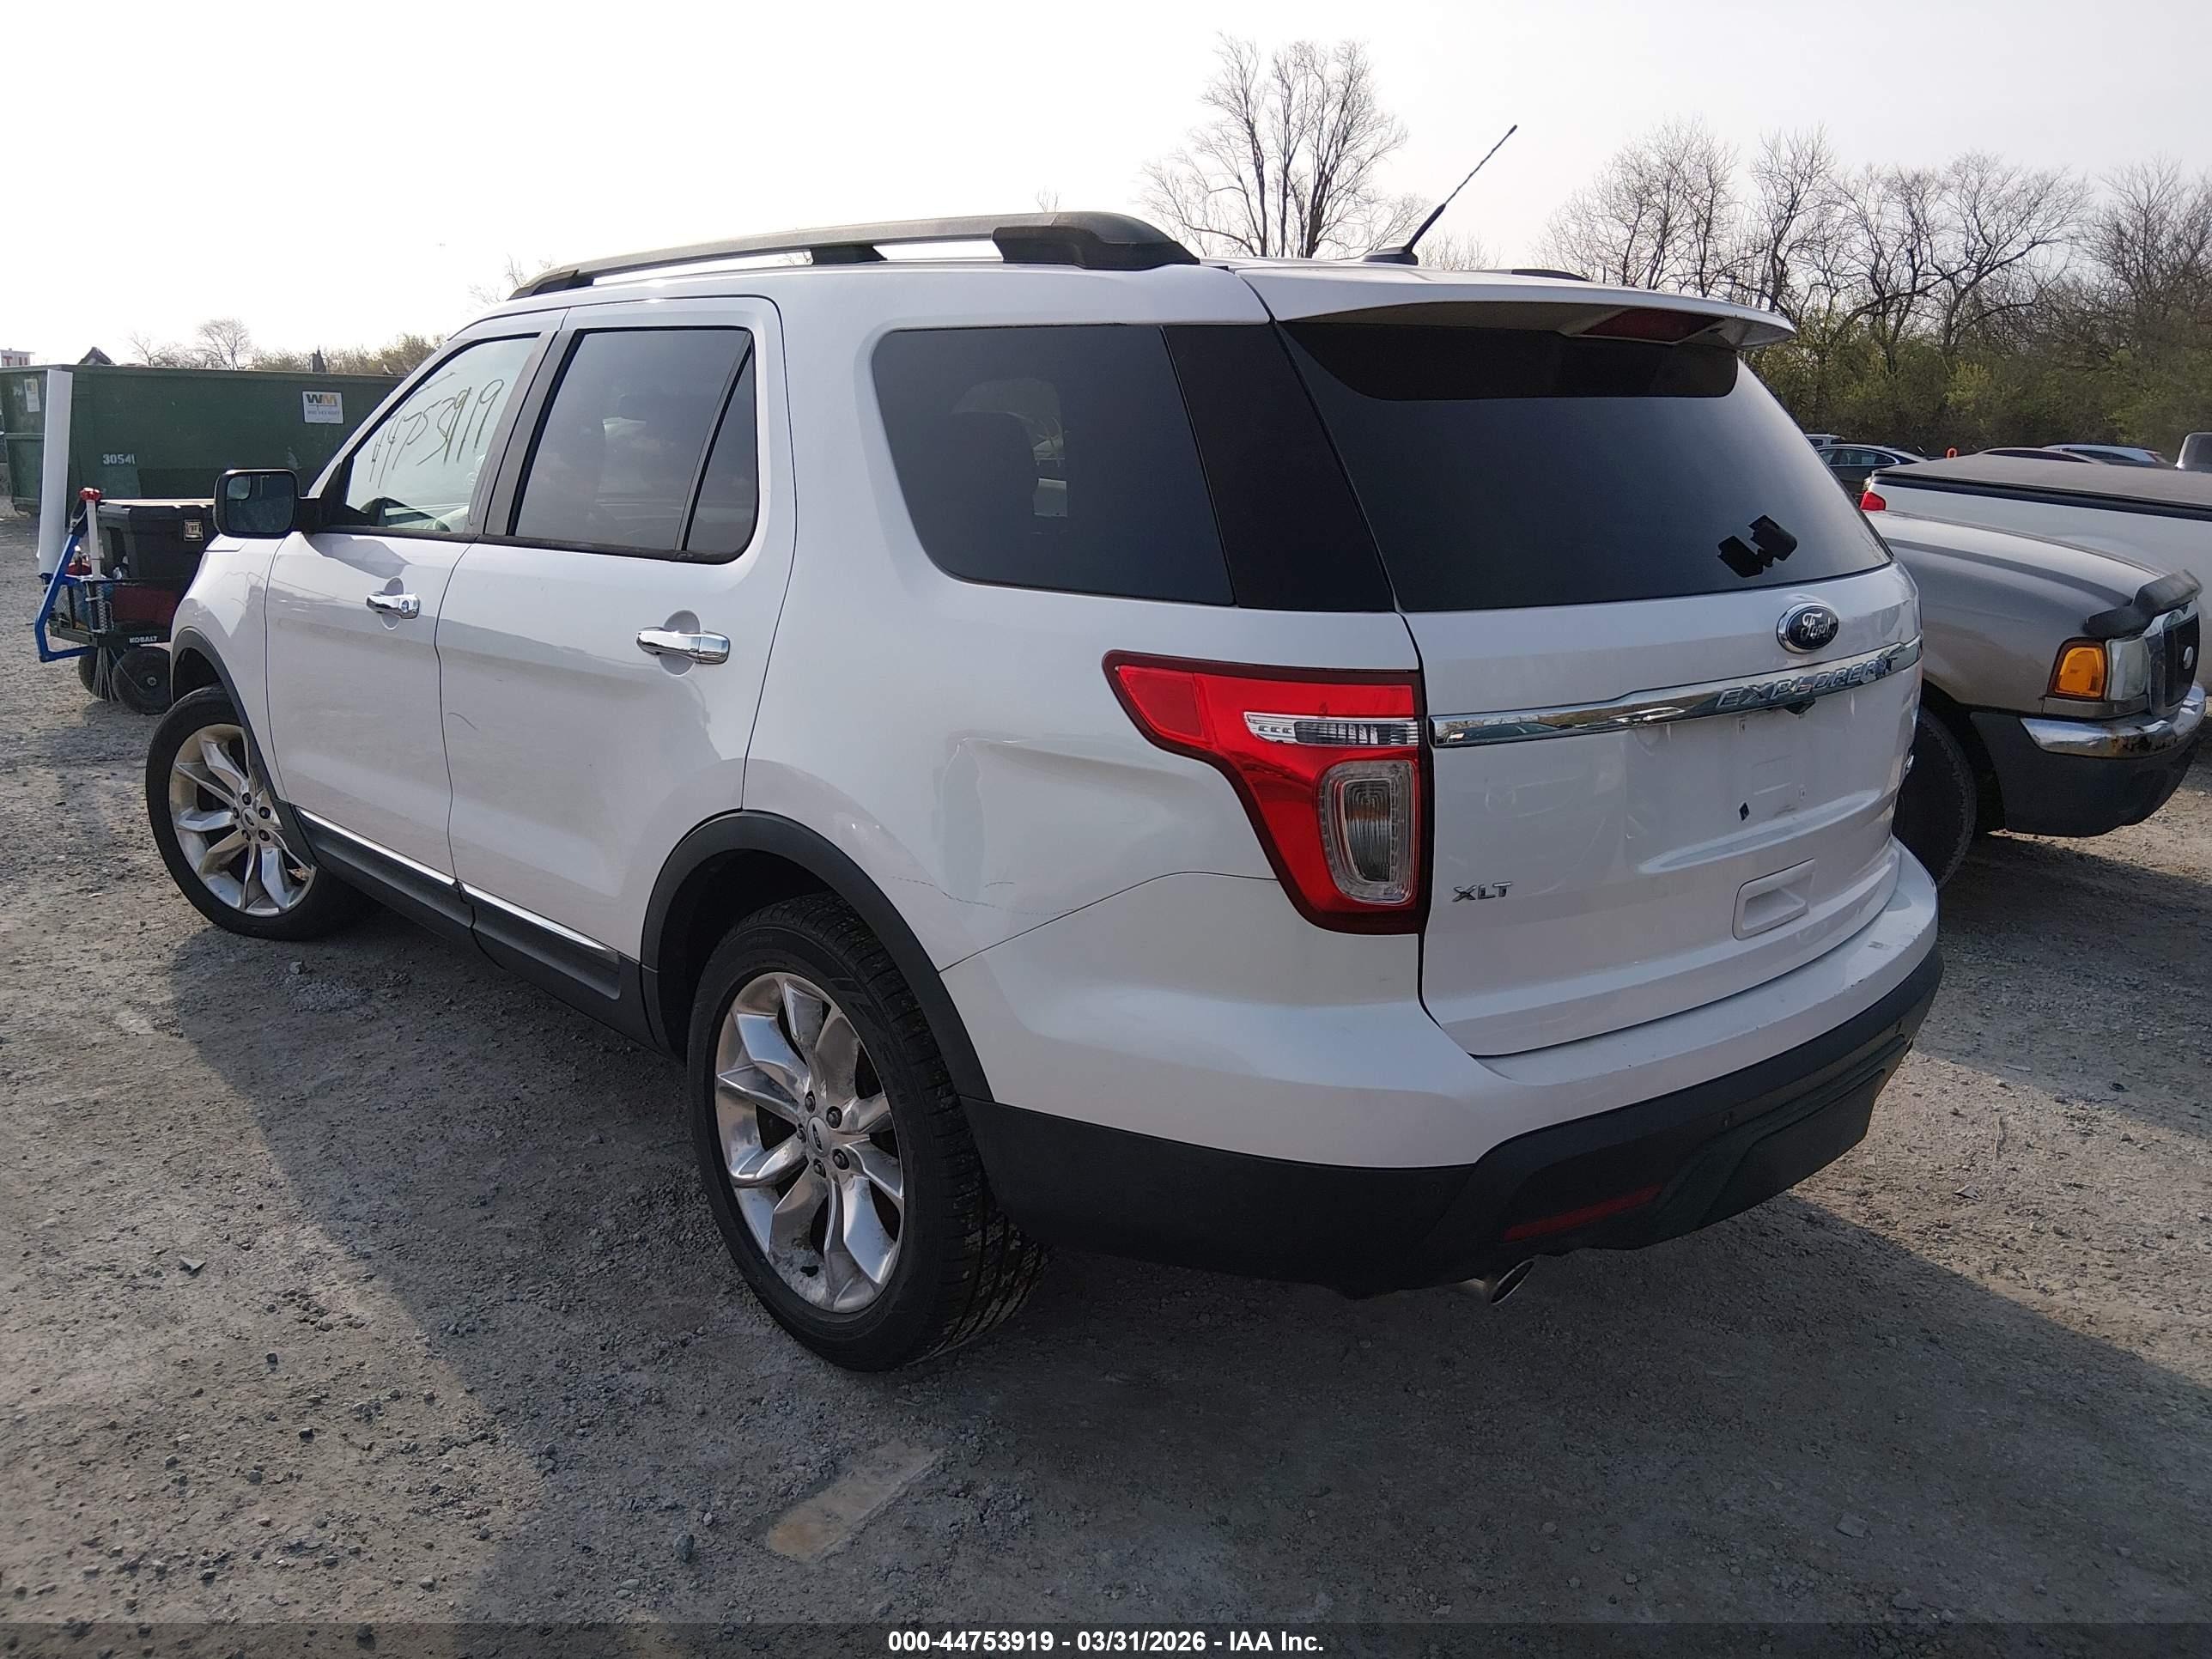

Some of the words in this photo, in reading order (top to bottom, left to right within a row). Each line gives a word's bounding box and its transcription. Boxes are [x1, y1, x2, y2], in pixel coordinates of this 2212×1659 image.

[306, 393, 337, 405] WM
[102, 453, 136, 465] 30541
[1800, 611, 1832, 640] Ford
[1716, 659, 1881, 708] EXPLORER
[1451, 881, 1513, 902] XLT
